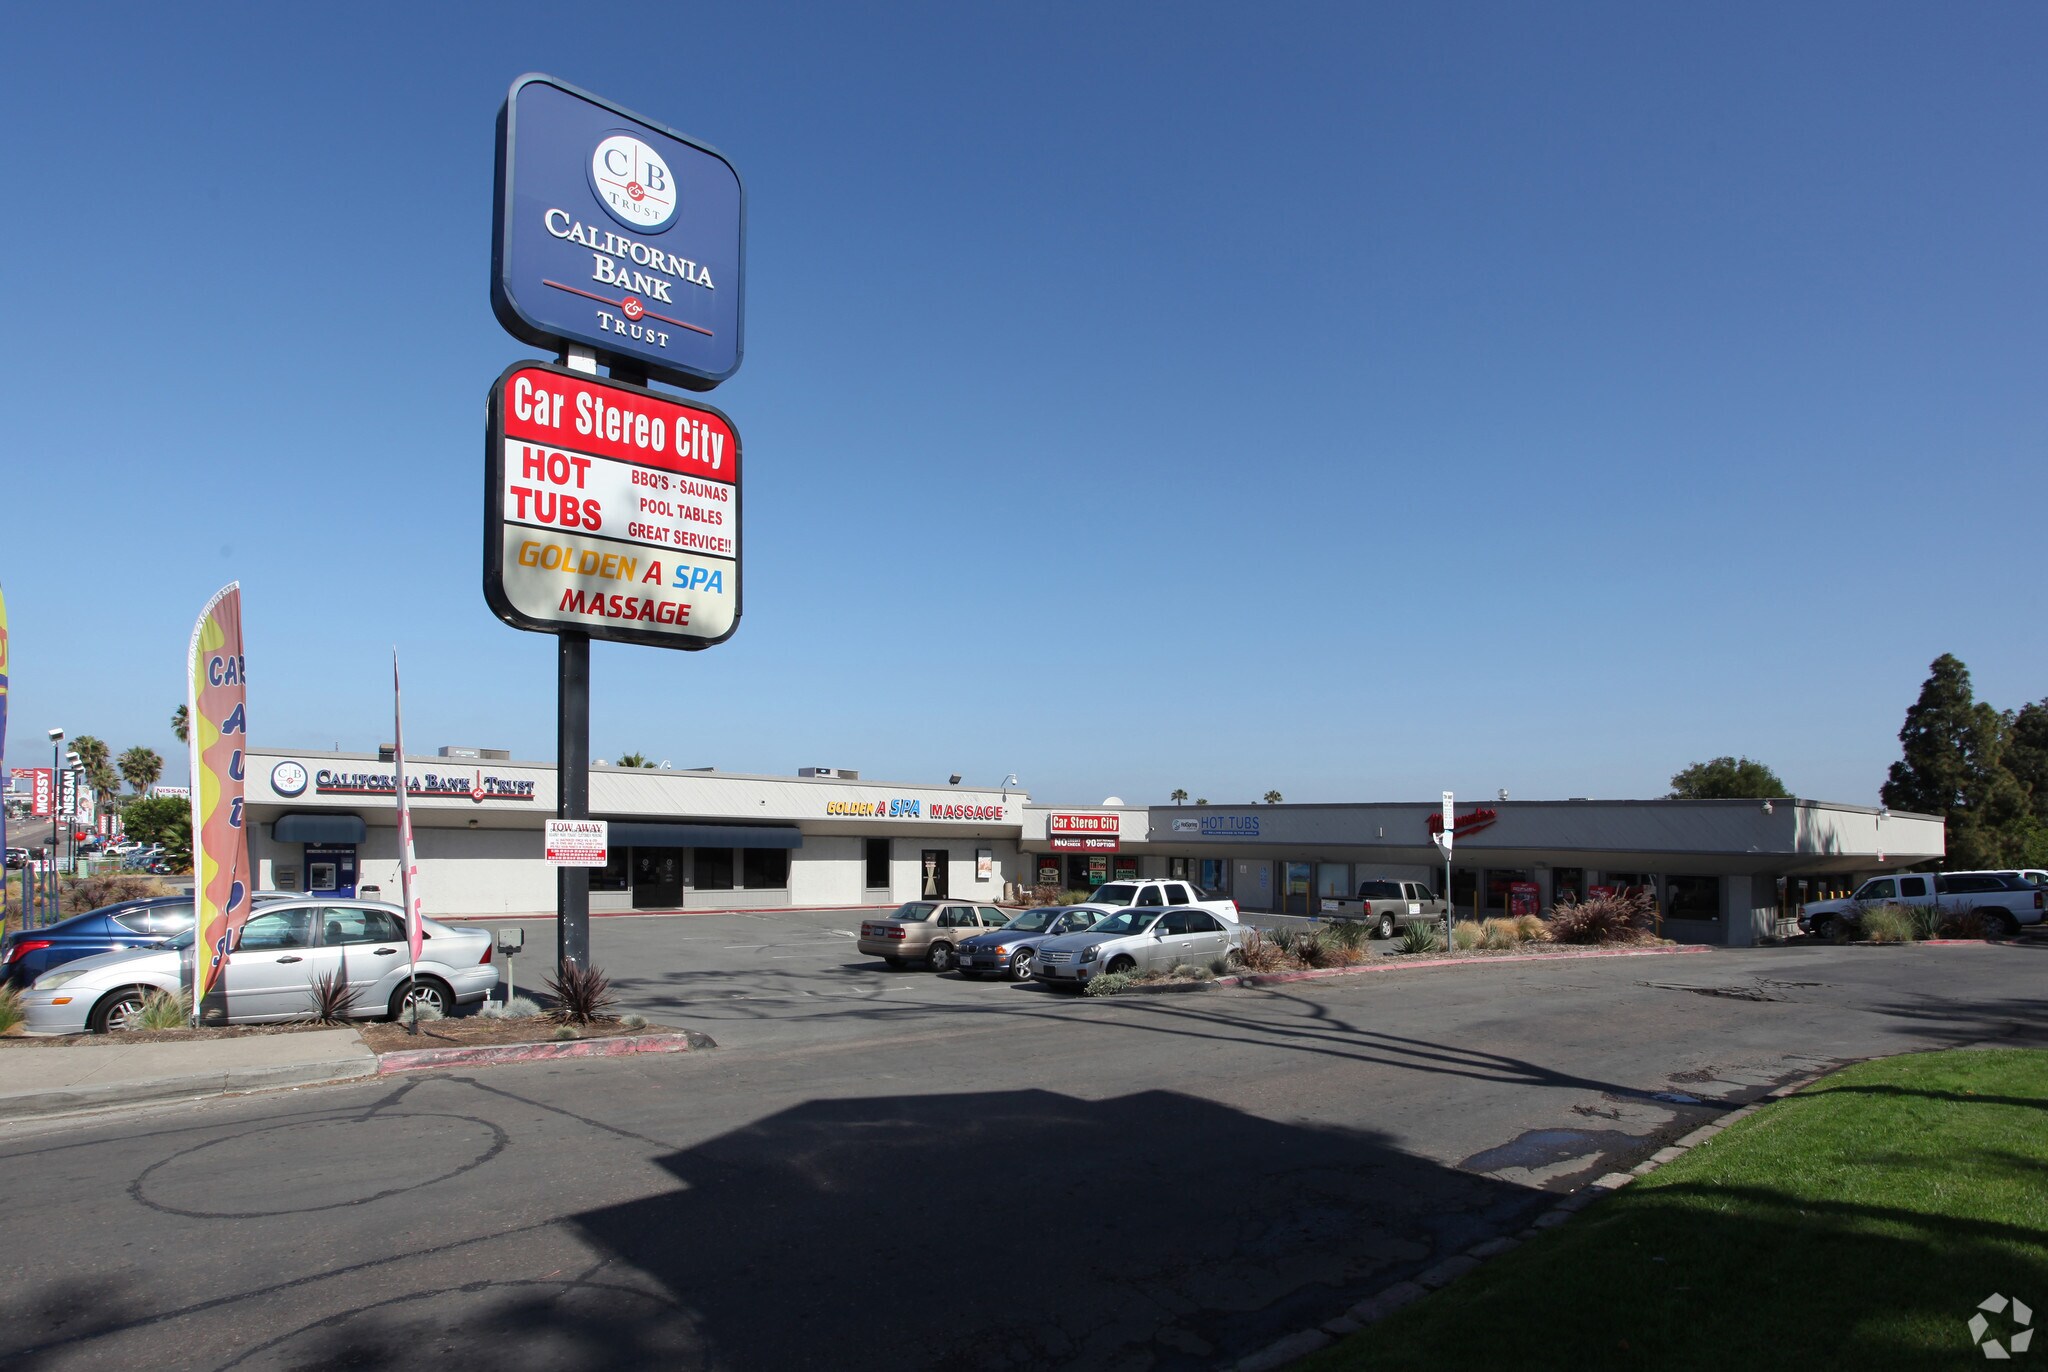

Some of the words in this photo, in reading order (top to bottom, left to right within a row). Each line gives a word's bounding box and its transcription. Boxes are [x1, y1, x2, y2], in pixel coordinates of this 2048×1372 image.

[604, 149, 628, 177] C
[644, 161, 666, 191] B
[609, 191, 661, 221] TRUST
[544, 208, 715, 289] CALIFORNIA
[592, 253, 673, 304] BANK
[597, 310, 669, 347] TRUST
[514, 376, 564, 428] Car
[575, 391, 665, 452] Stereo
[675, 416, 724, 470] City
[522, 446, 592, 489] HOT
[631, 469, 669, 491] BBQ'S
[680, 480, 728, 503] SAUNAS
[510, 485, 602, 531] TUBS
[640, 498, 673, 518] POOL
[677, 504, 723, 525] TABLES
[628, 521, 670, 542] GREAT
[673, 530, 732, 554] SERVICE!!
[518, 540, 638, 582] GOLDEN
[641, 560, 662, 585] A
[672, 564, 723, 594] SPA
[559, 588, 692, 626] MASSAGE
[36, 770, 49, 813] MOSSY
[63, 771, 75, 814] NISSAN
[425, 773, 471, 789] BANK
[484, 776, 535, 793] TRUST
[827, 800, 874, 815] GOLDEN
[875, 801, 886, 816] A
[889, 799, 920, 817] SPA
[930, 803, 1003, 819] MASSAGE
[1053, 816, 1068, 828] Car
[1070, 816, 1098, 829] Stereo
[1101, 817, 1118, 831] City
[1201, 816, 1224, 829] HOT
[1228, 816, 1260, 829] TUBS
[551, 822, 573, 832] TOW
[576, 823, 603, 833] AWAY
[1054, 838, 1067, 847] NO
[1085, 838, 1096, 848] 90
